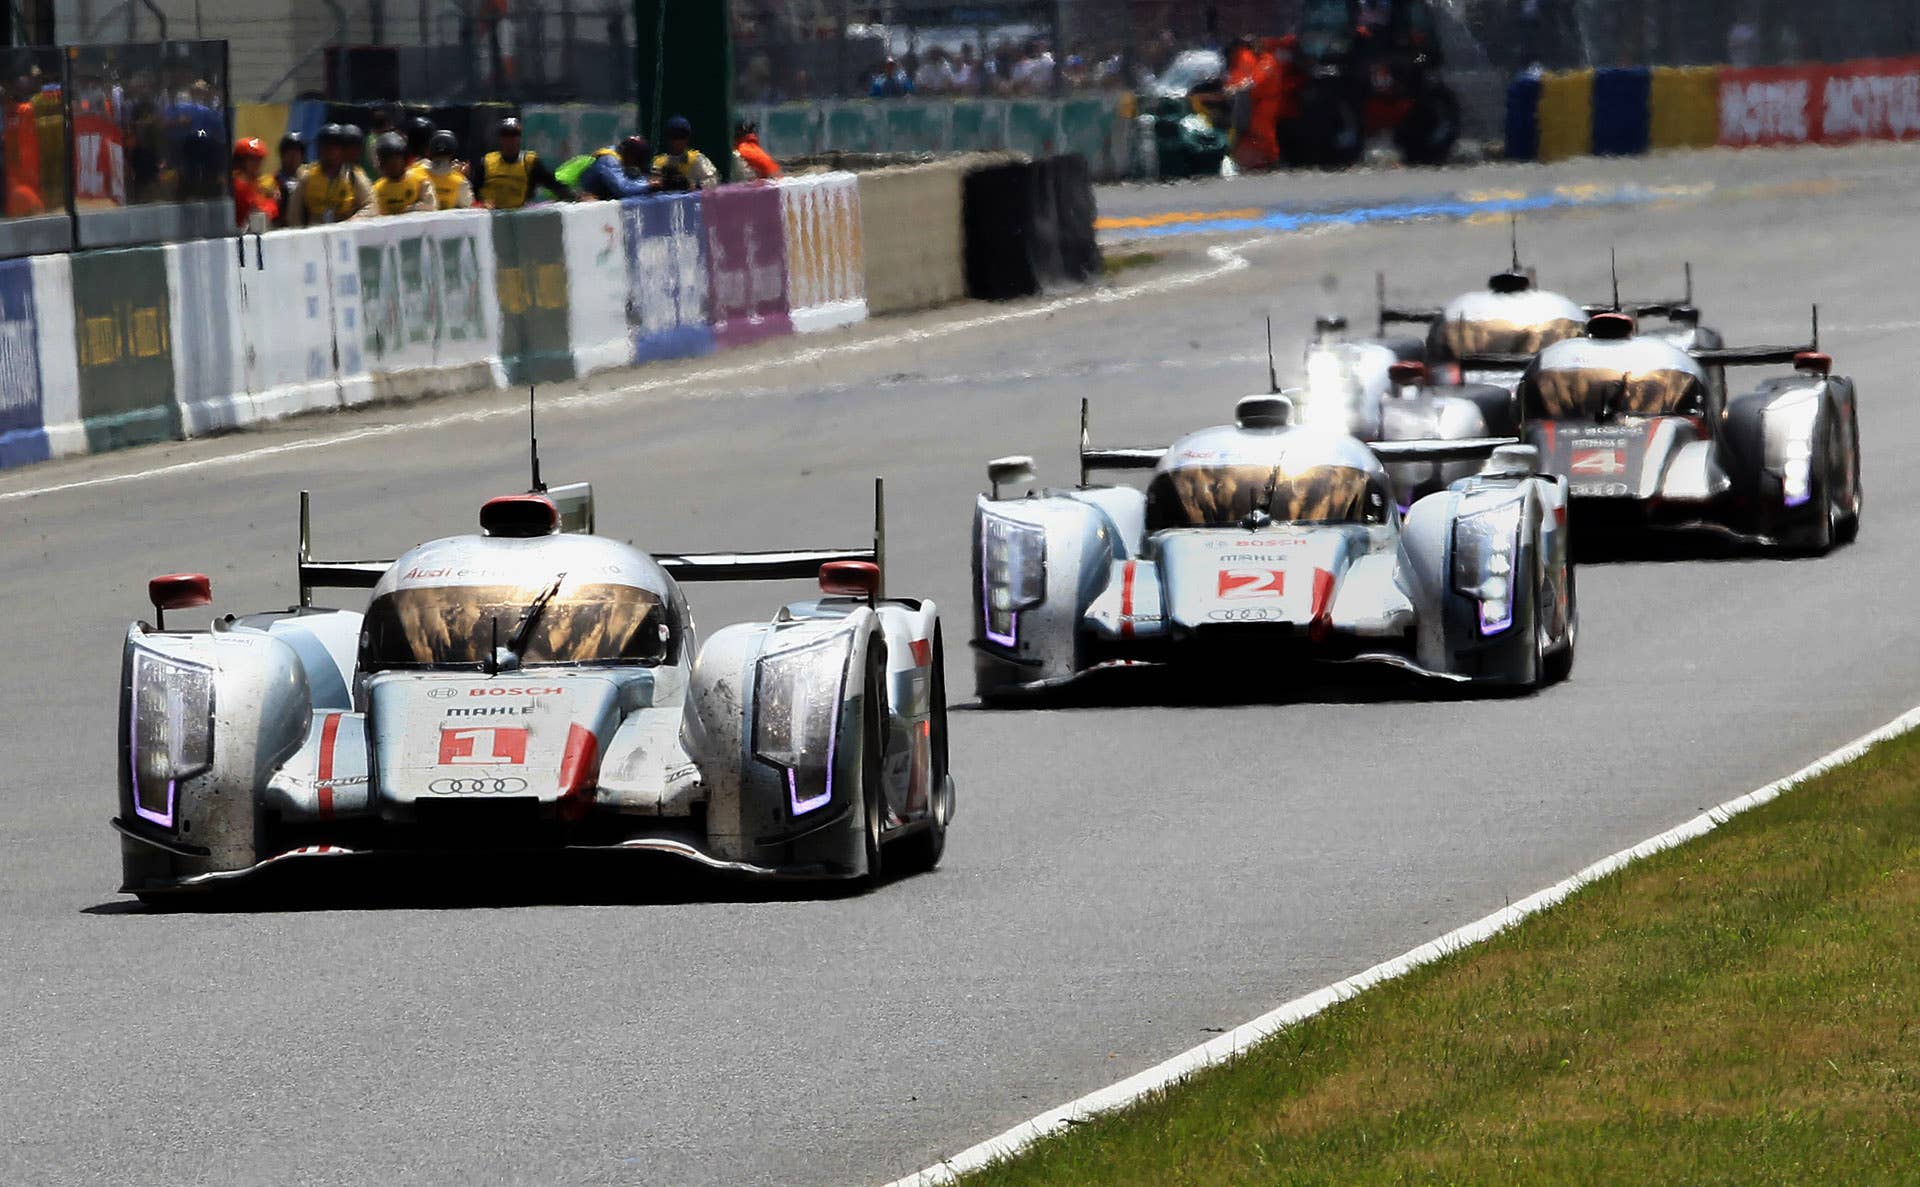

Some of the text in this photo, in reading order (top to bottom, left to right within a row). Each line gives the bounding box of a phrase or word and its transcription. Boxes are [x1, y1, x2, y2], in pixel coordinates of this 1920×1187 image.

[1571, 449, 1625, 473] 4
[403, 566, 451, 580] Audi
[1222, 569, 1283, 598] 2
[469, 687, 563, 697] BOSCH
[446, 706, 535, 717] MAHLE
[450, 729, 513, 764] 1
